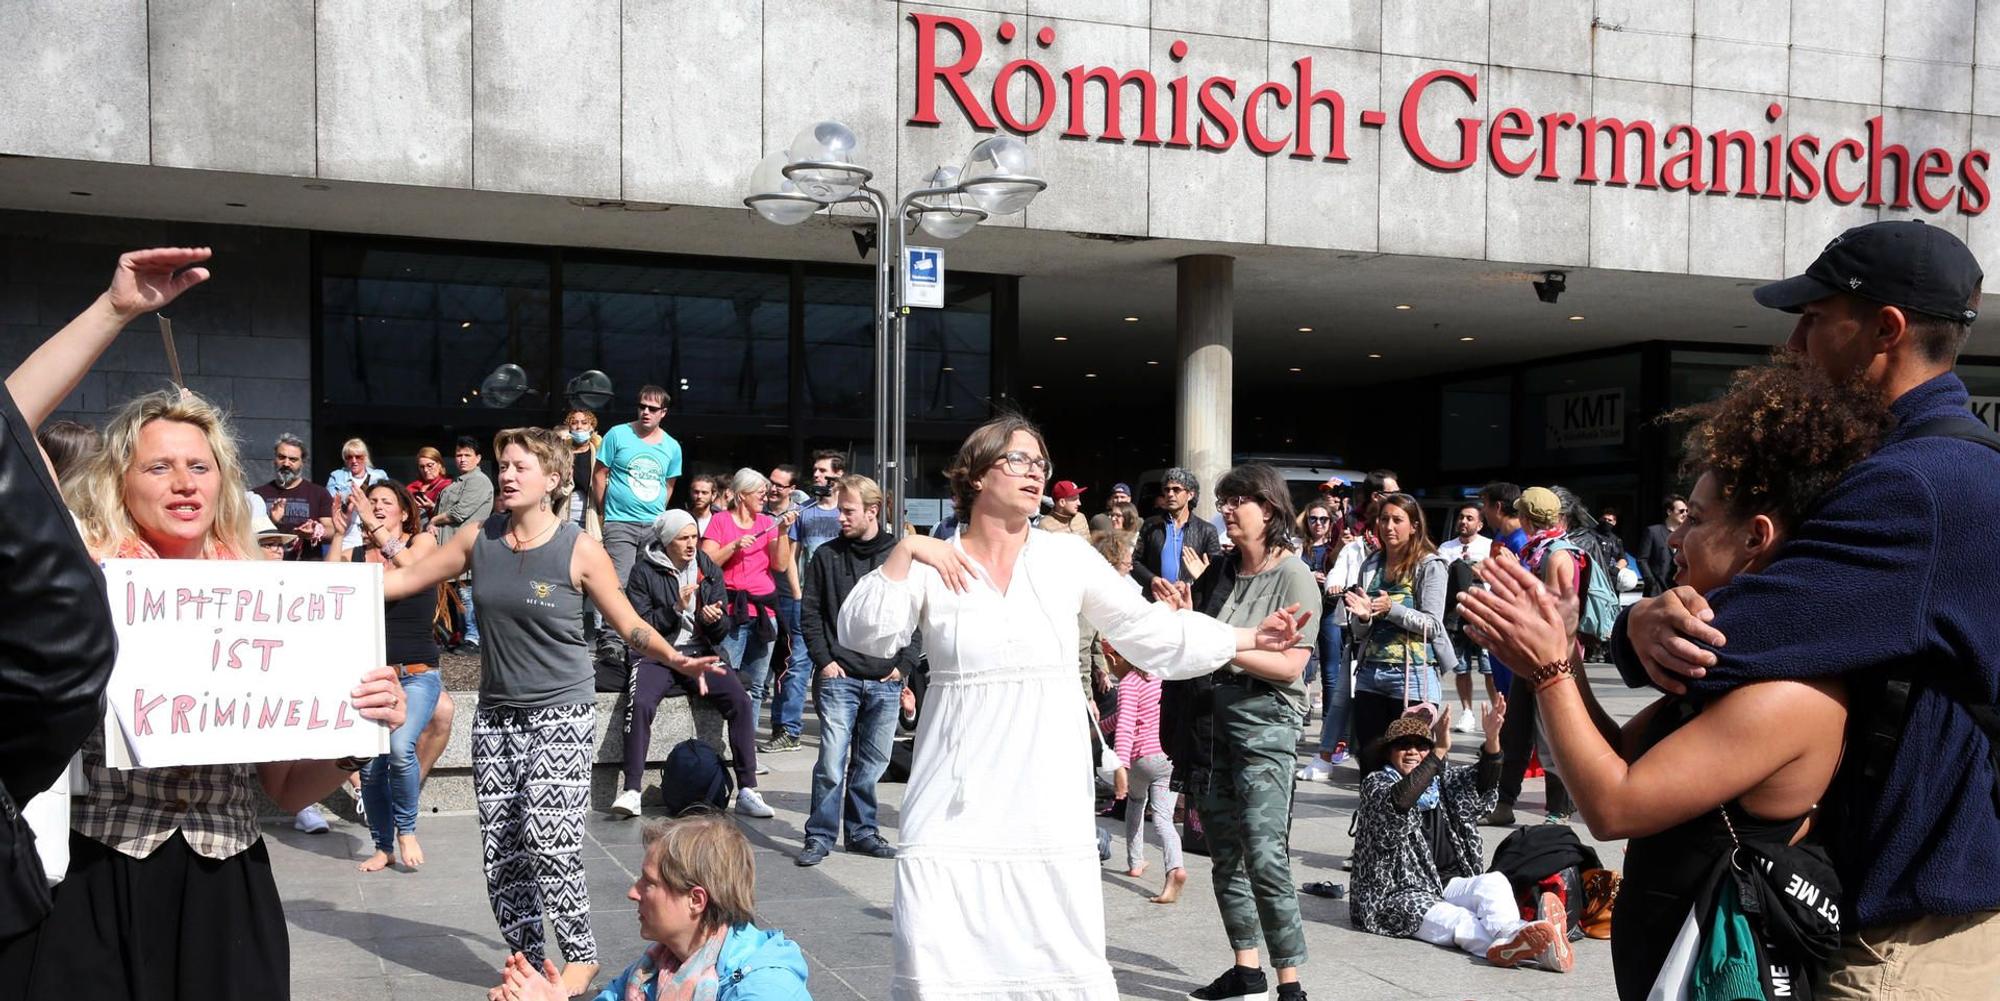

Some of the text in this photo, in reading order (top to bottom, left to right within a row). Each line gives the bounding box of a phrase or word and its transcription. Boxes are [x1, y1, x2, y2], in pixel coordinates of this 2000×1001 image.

[908, 13, 1990, 214] Römisch-Germanisches
[1563, 393, 1620, 430] KMT
[1784, 873, 1820, 907] ME
[1770, 965, 1791, 997] ME
